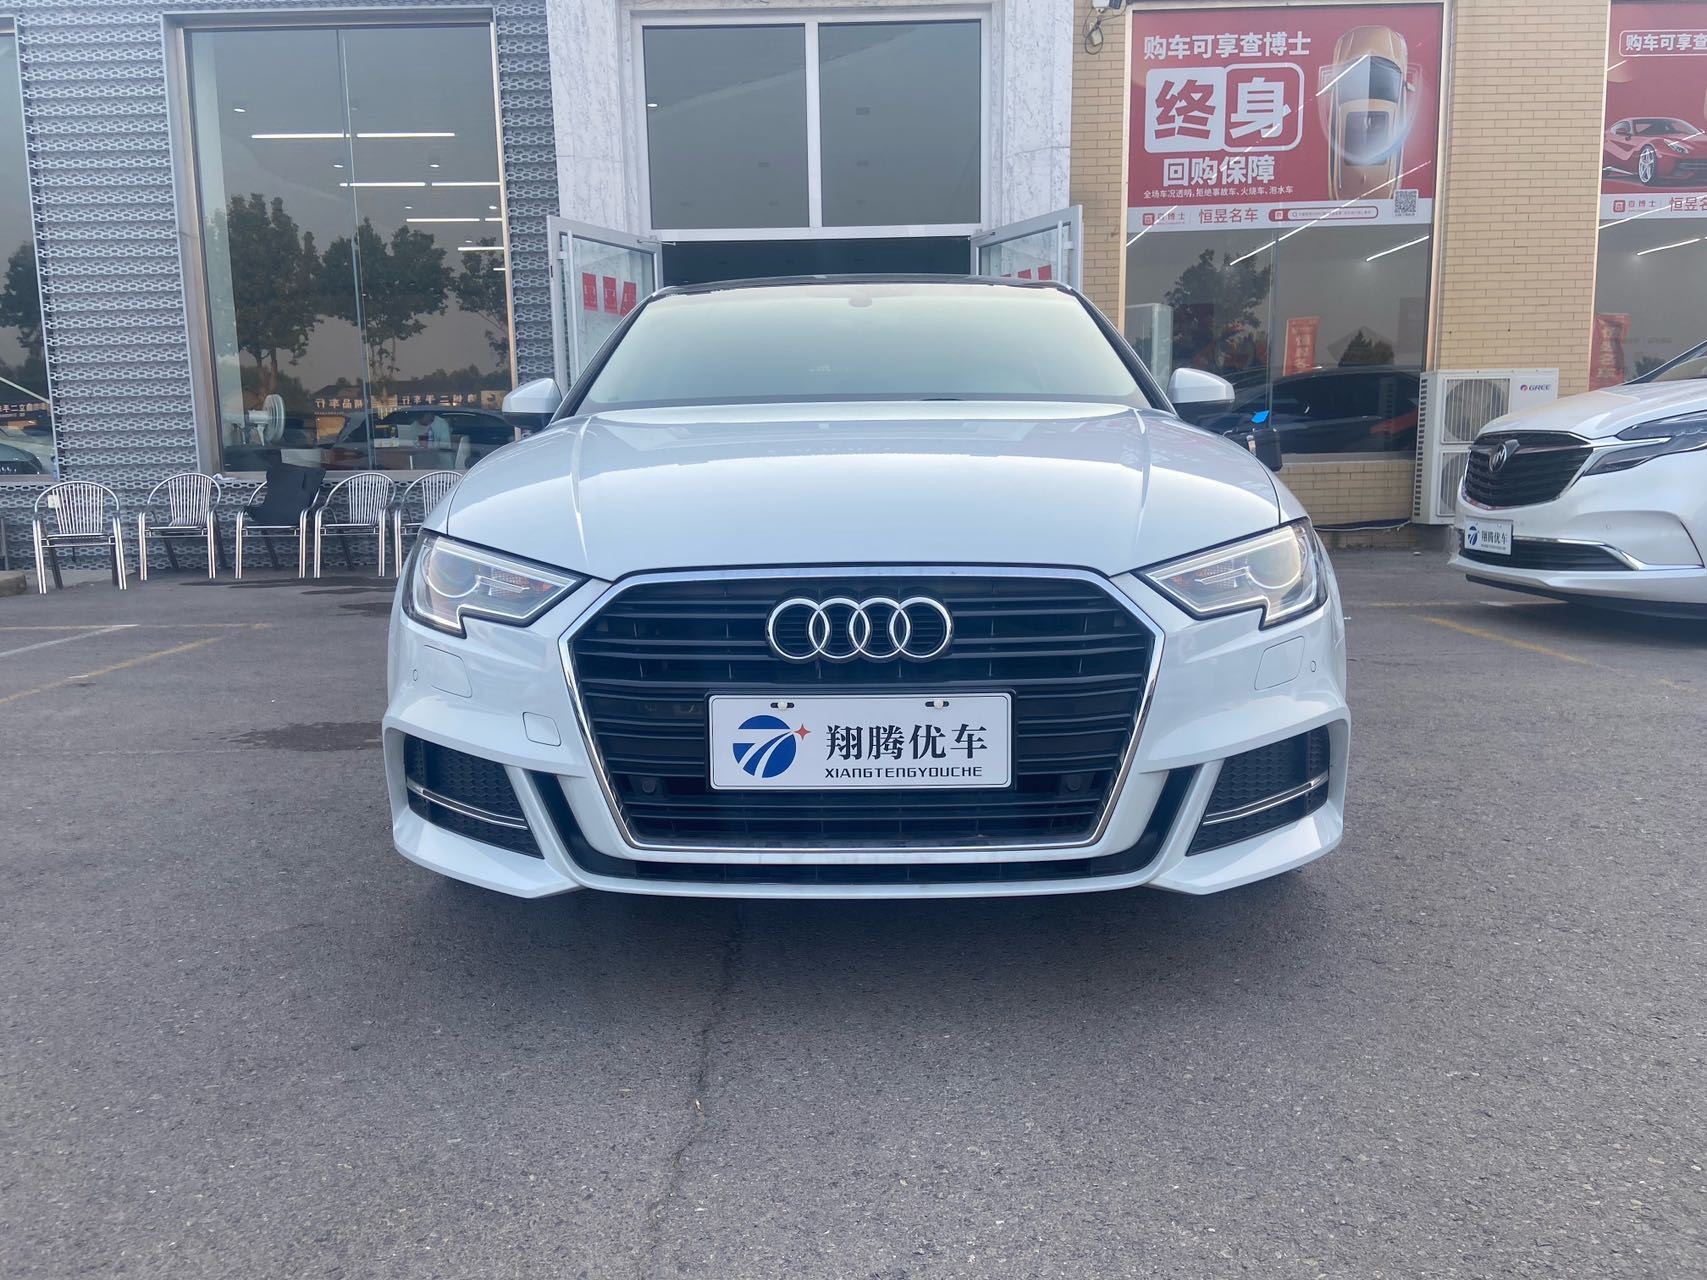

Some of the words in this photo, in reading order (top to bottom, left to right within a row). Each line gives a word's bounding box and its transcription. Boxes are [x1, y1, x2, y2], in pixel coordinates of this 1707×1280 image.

[1144, 31, 1311, 60] 购车可享查博士
[1154, 76, 1291, 141] 终身
[1163, 154, 1276, 187] 回购保障
[1199, 207, 1259, 224] 恒昱名车
[1529, 384, 1552, 392] GREE
[825, 723, 988, 761] 翔腾优车
[824, 766, 983, 779] XIANGTENGYOUCHE
